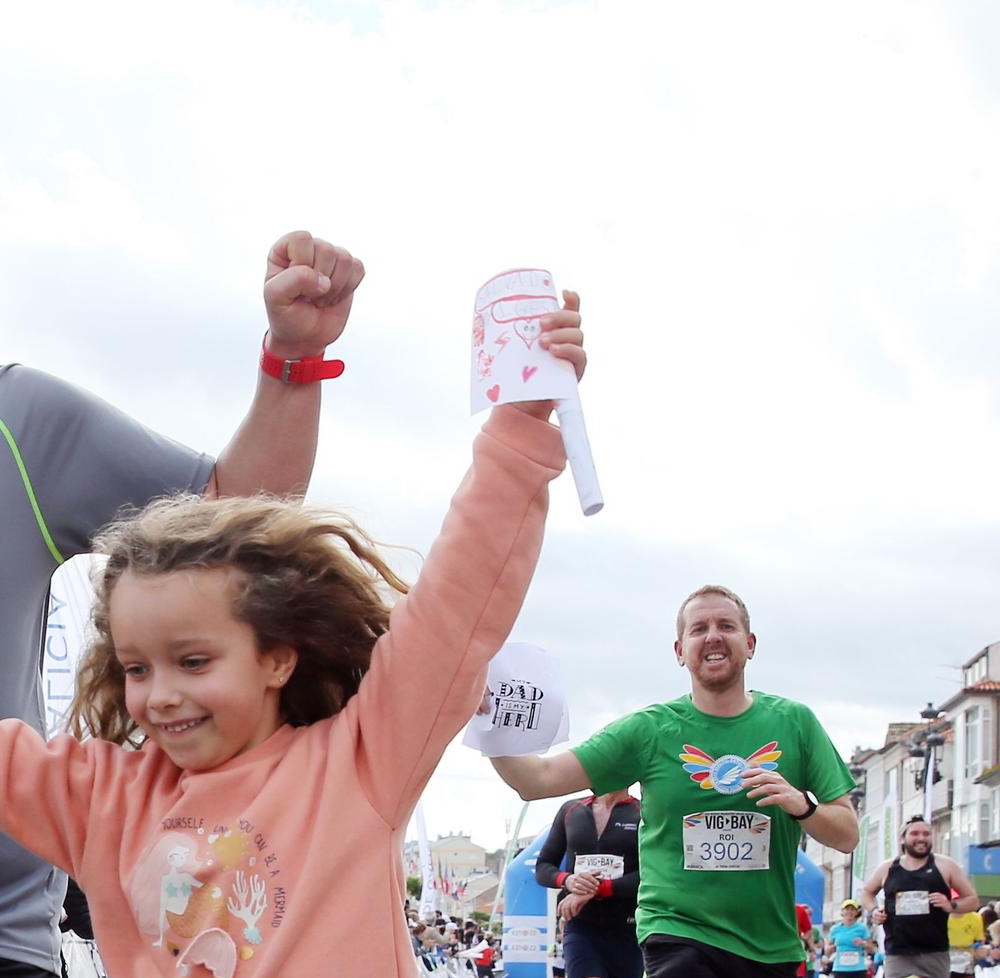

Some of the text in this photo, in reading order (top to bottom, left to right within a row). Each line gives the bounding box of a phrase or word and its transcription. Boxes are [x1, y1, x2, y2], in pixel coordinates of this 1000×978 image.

[496, 681, 543, 701] DAD
[705, 815, 754, 829] VIG BAY
[700, 842, 753, 860] 3902
[271, 887, 286, 928] MERMAID
